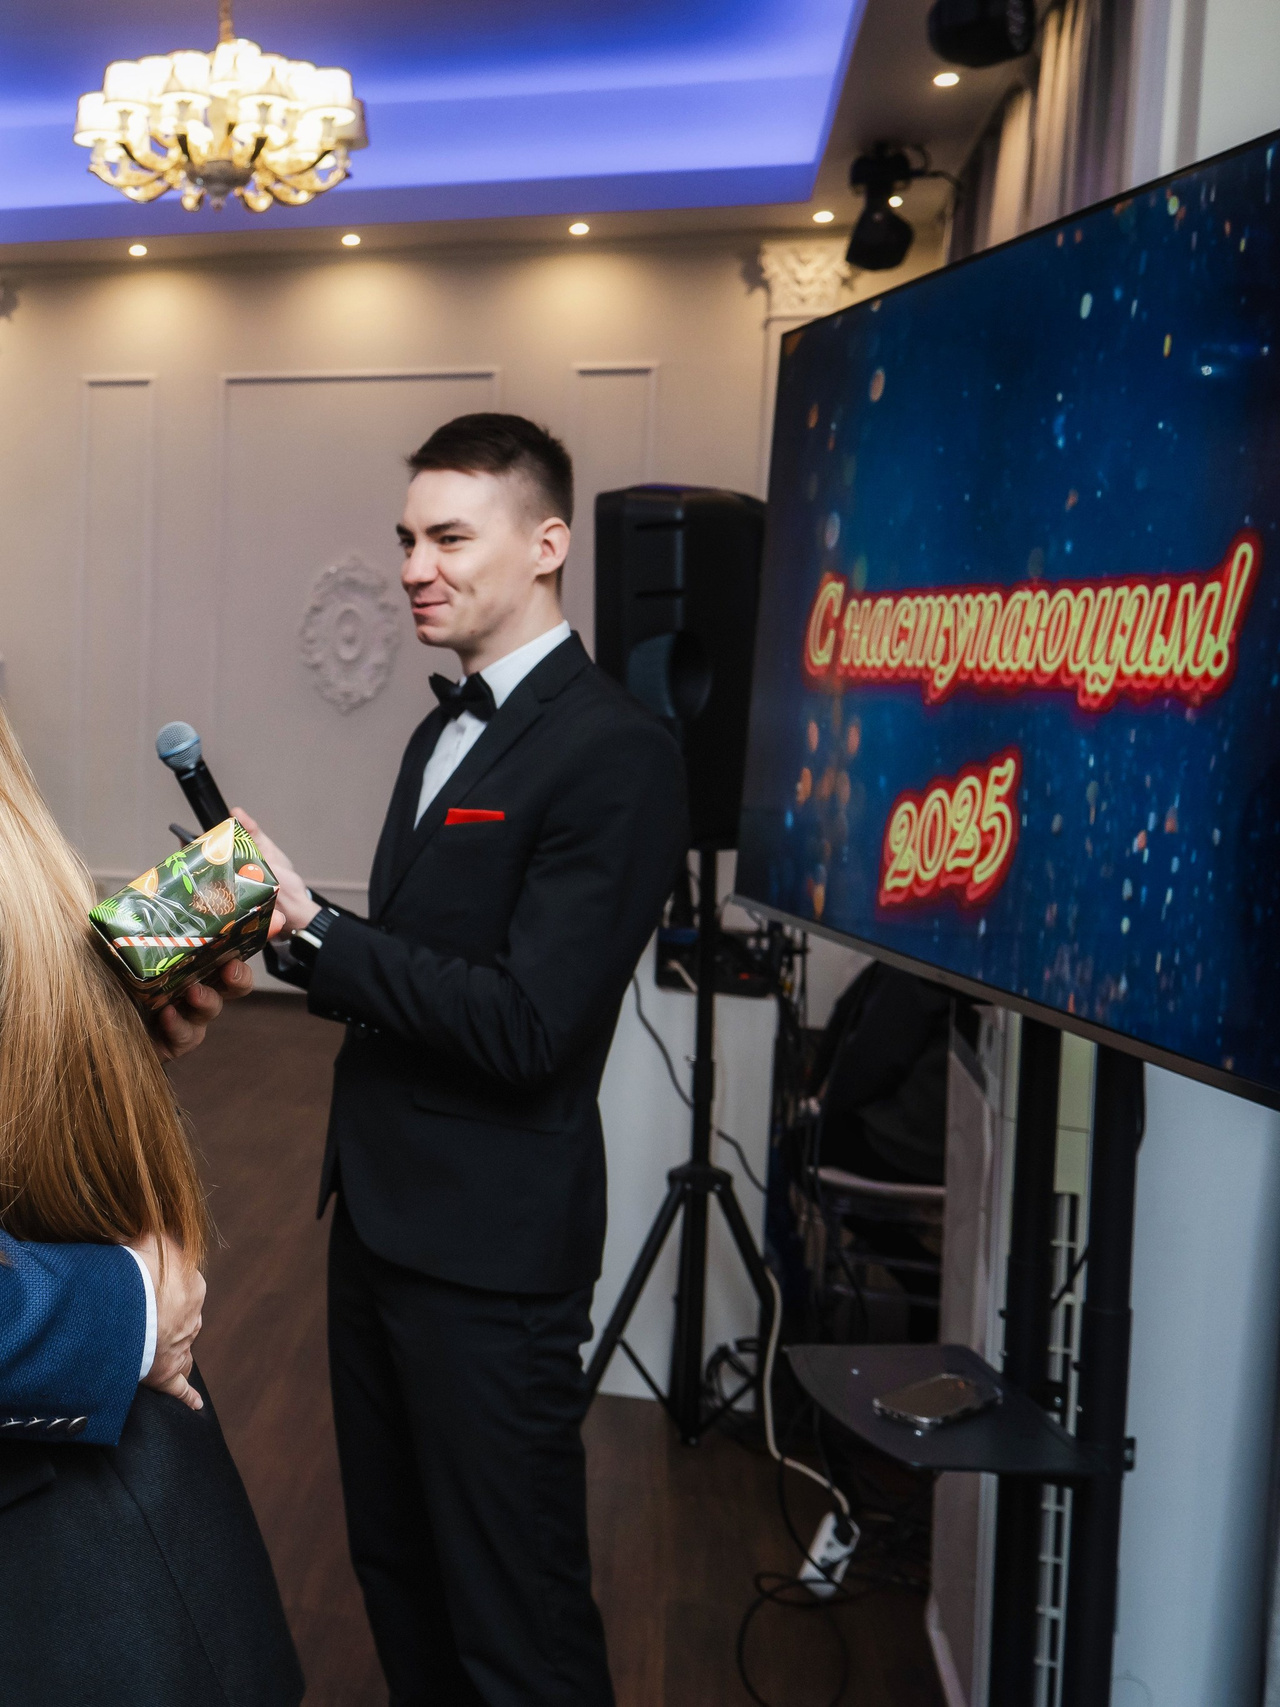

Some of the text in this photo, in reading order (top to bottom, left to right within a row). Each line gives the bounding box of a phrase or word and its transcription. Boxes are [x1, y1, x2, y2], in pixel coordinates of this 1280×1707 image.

[807, 541, 1255, 697] С наступающим!
[883, 756, 1017, 897] 2025
